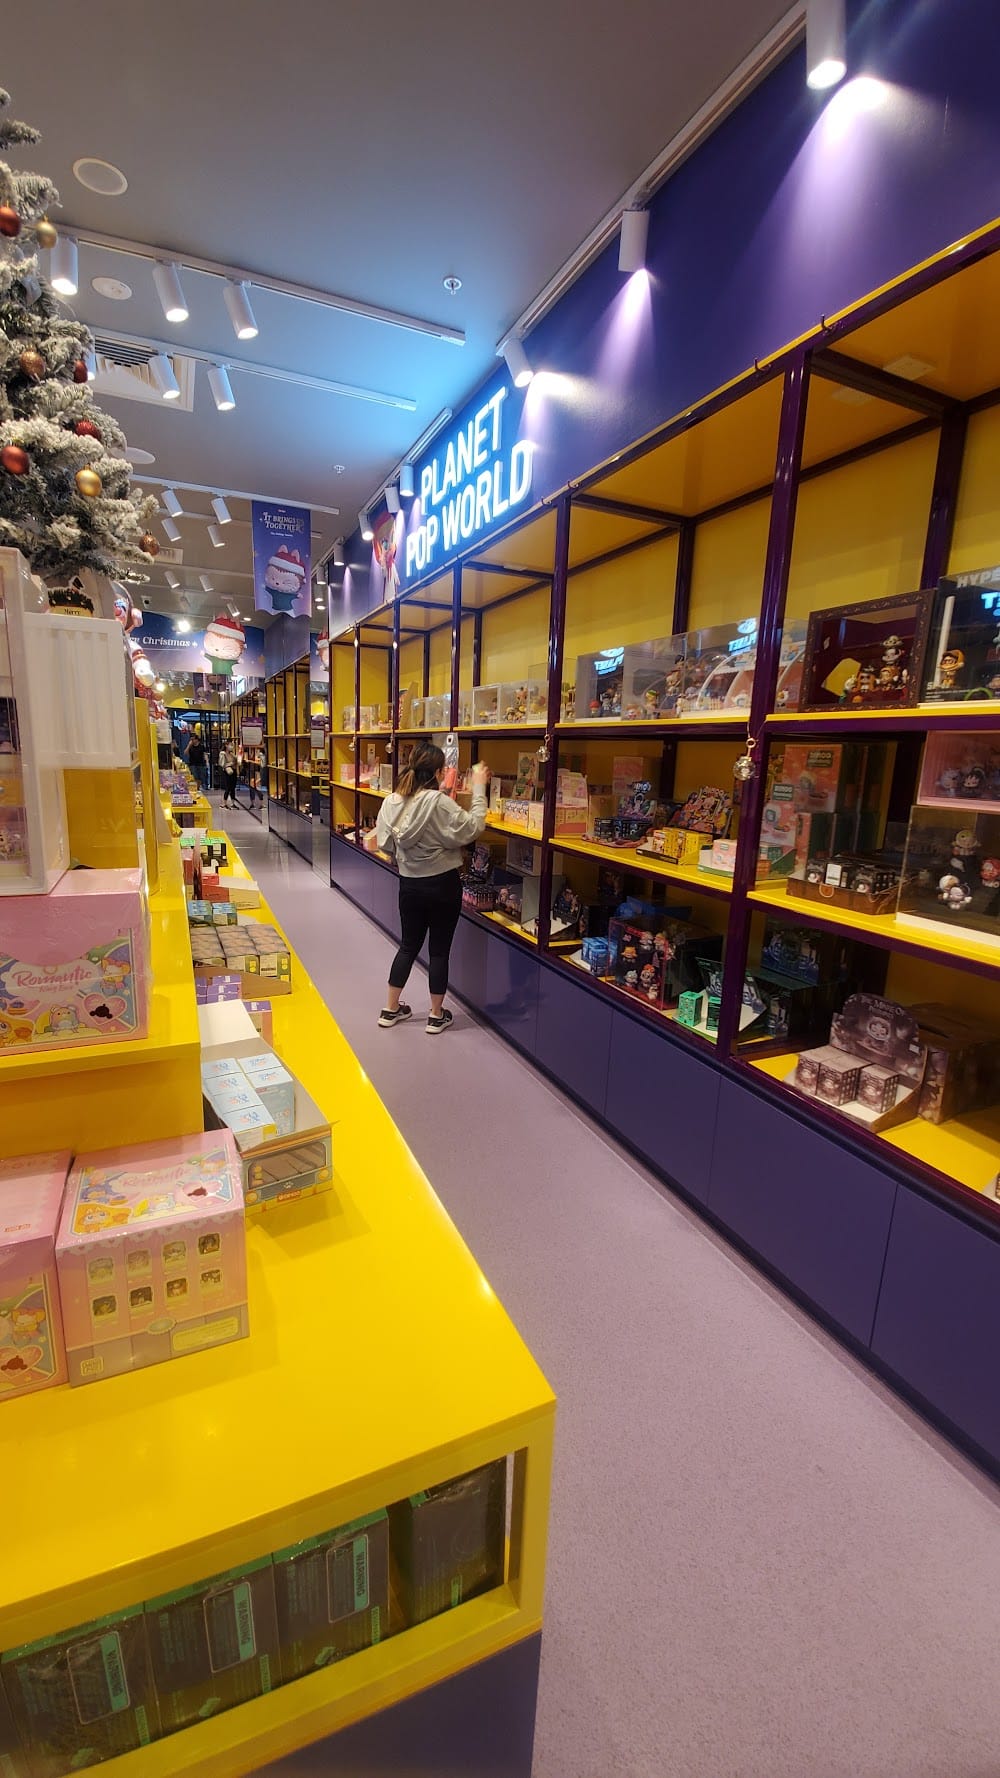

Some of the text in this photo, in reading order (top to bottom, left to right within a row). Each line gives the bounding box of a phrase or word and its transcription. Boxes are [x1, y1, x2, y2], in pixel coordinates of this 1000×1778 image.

[421, 386, 508, 515] PLANET
[406, 440, 535, 577] POP WORLD
[142, 636, 191, 647] Christmas
[12, 965, 92, 987] Romantic
[355, 1551, 366, 1598] WARNING
[237, 1599, 251, 1646] WARNING
[106, 1649, 124, 1698] WARNING
